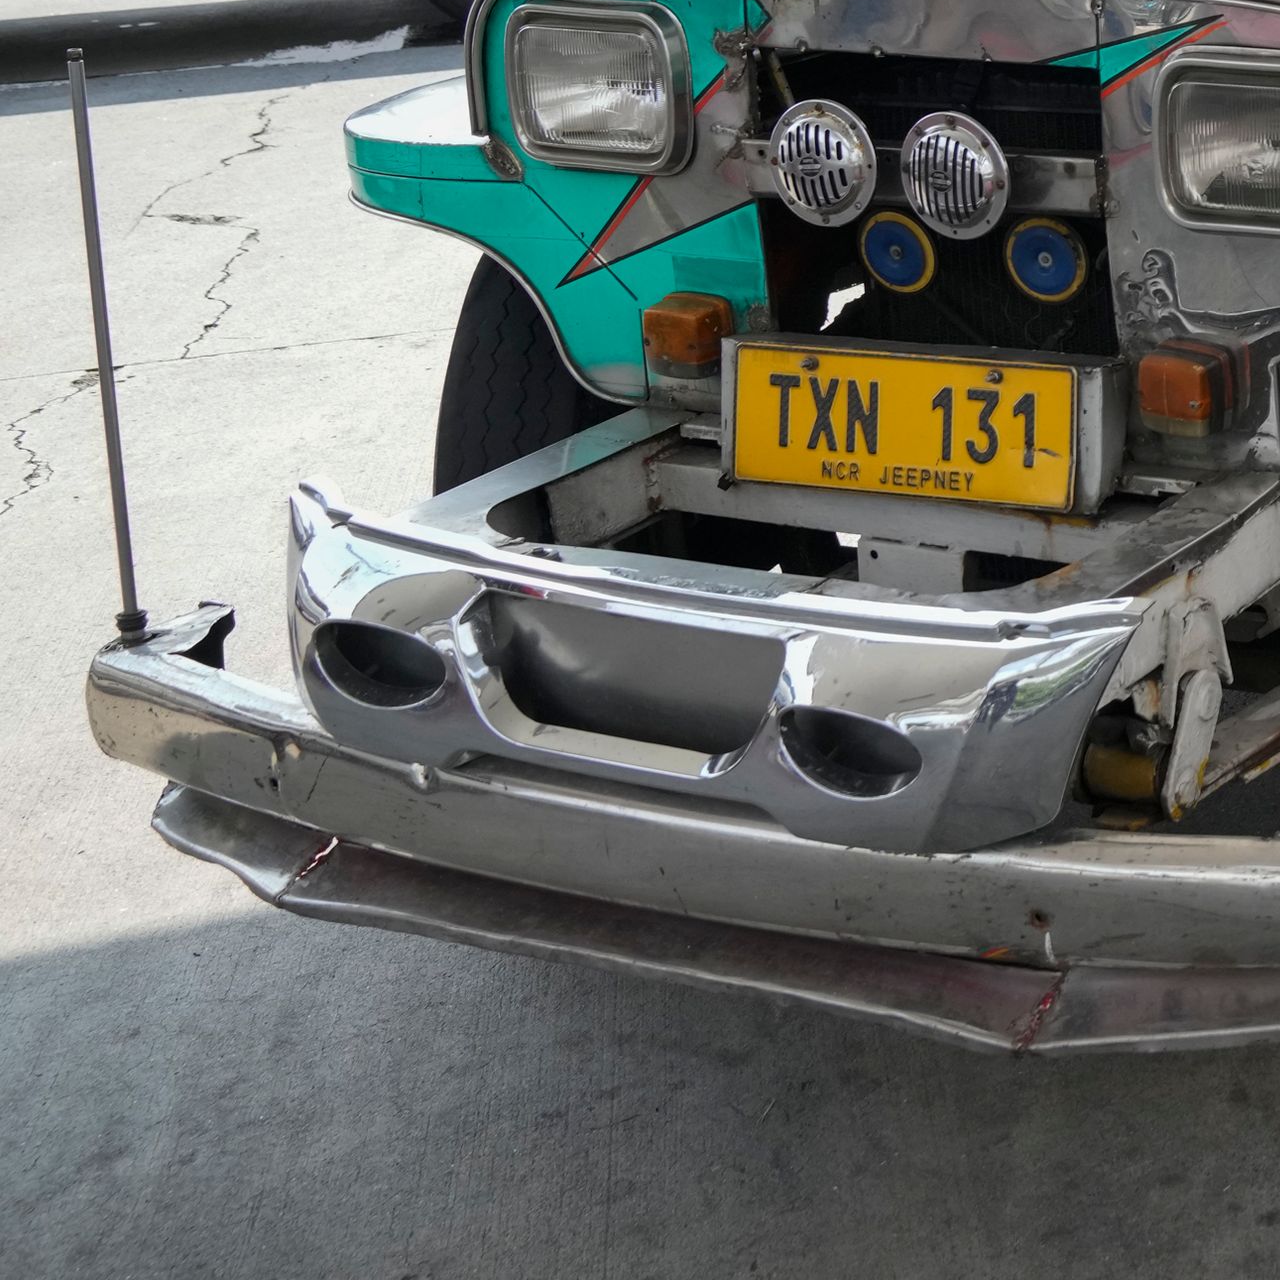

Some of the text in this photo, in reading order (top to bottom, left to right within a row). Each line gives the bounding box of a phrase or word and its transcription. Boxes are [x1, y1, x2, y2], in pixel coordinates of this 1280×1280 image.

[769, 372, 1038, 469] TXN 131
[822, 459, 975, 492] NCR JEEPNEY
